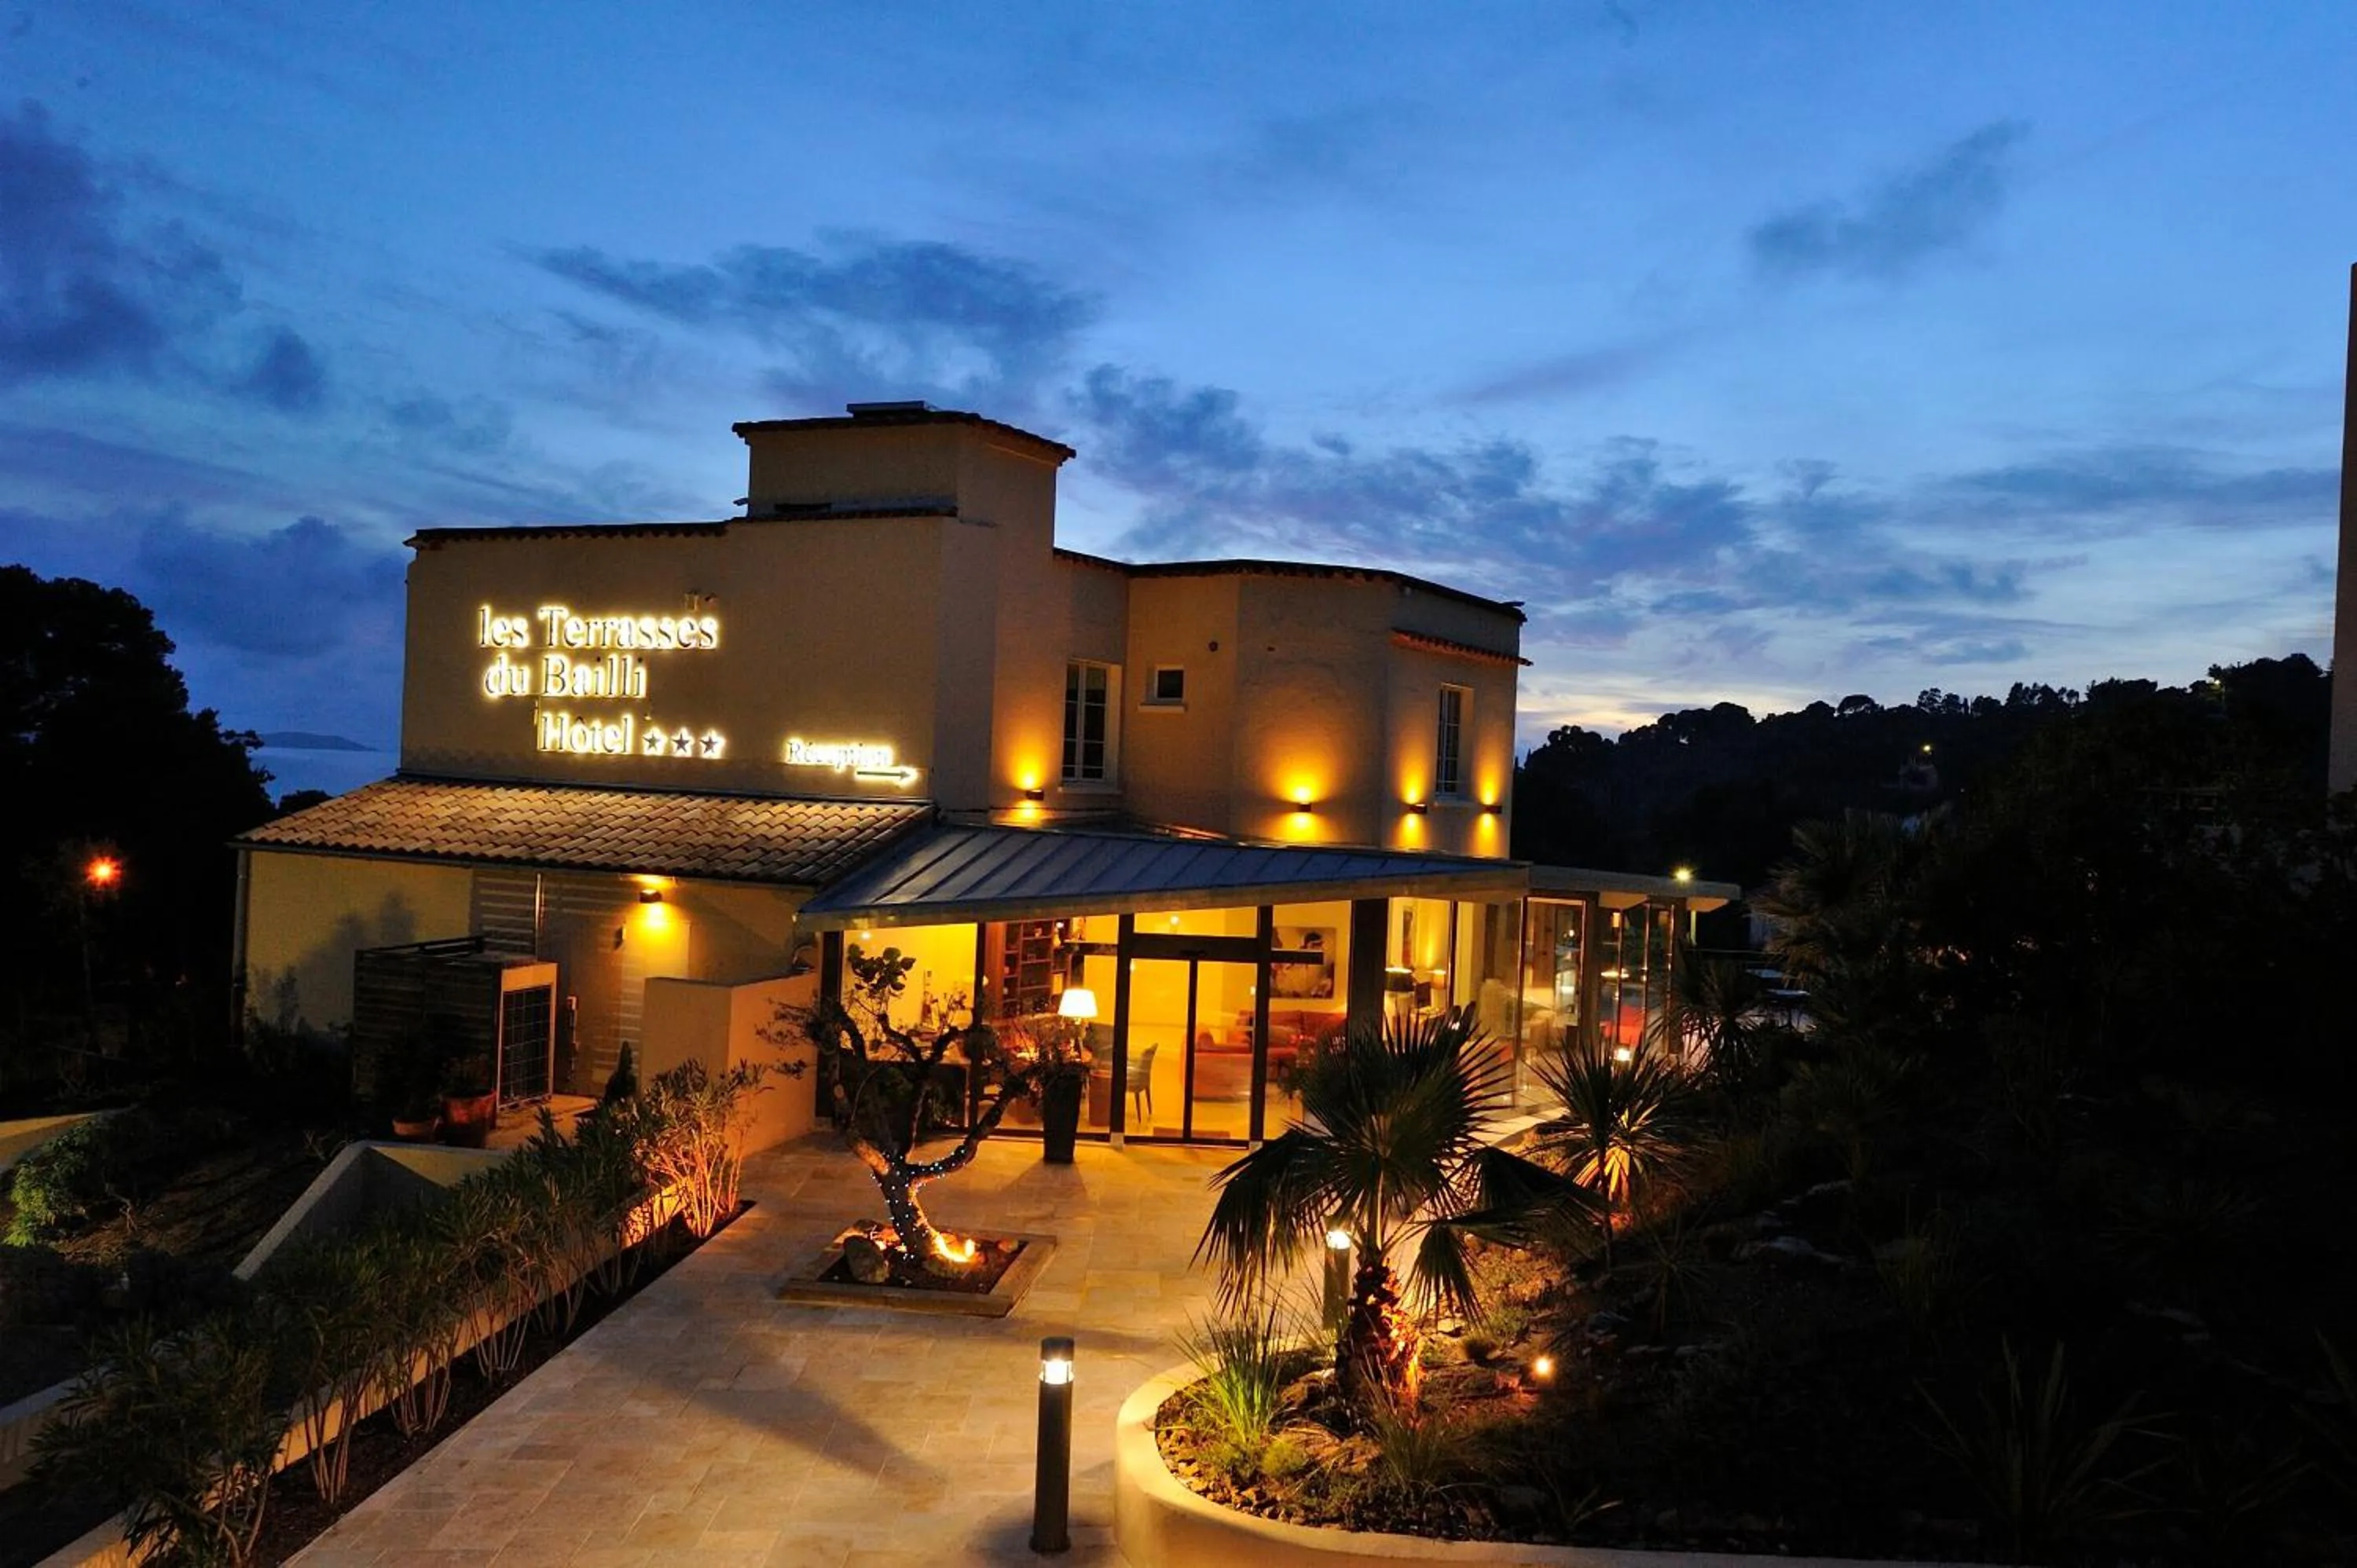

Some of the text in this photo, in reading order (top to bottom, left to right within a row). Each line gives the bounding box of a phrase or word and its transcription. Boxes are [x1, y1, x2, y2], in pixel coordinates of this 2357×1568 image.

[478, 606, 718, 648] les Terrasses
[484, 654, 647, 697] du Bailli
[541, 713, 633, 753] Hôtel
